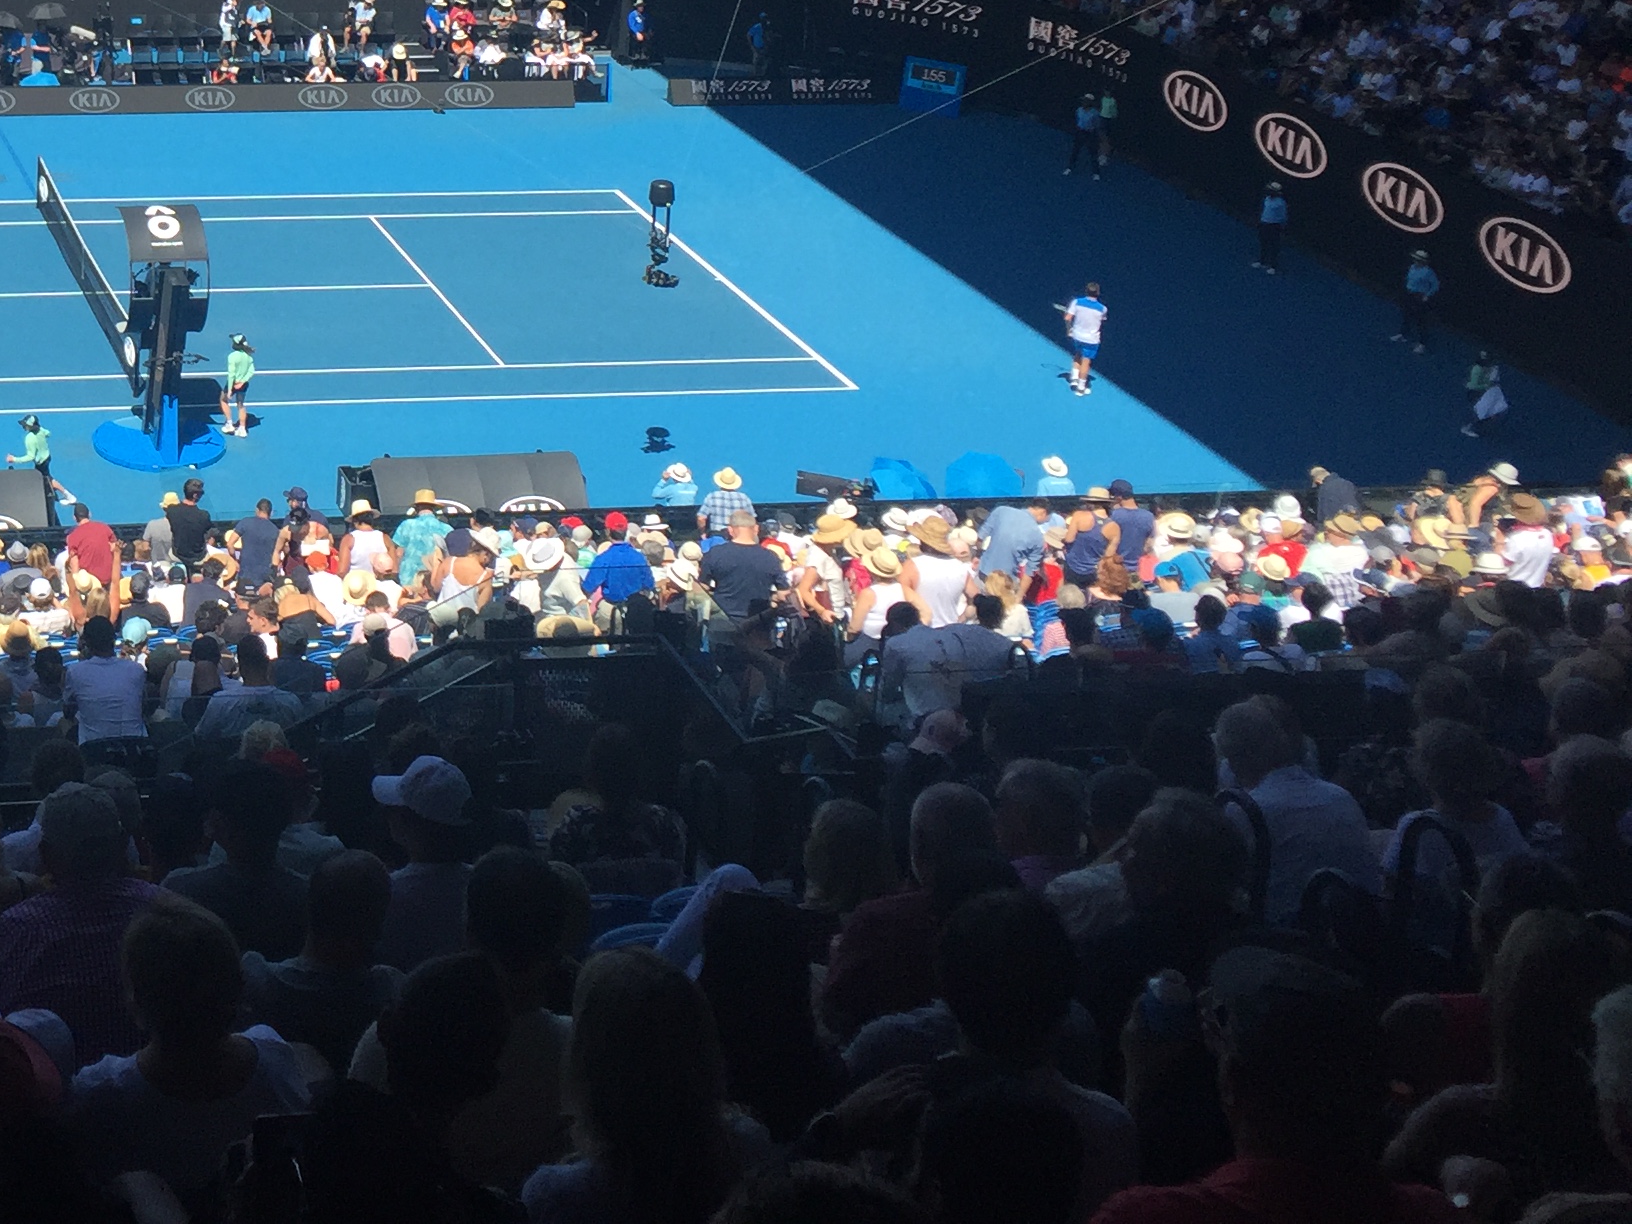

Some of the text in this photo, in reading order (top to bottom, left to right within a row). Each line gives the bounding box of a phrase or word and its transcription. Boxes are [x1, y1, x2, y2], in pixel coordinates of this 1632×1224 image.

[922, 69, 947, 83] 155
[78, 93, 112, 107] KIA
[193, 91, 227, 105] KIA
[306, 91, 341, 104] KIA
[380, 89, 414, 103] KIA
[453, 88, 487, 102] KIA
[1174, 78, 1216, 124] KIA
[1268, 121, 1313, 170] KIA
[1376, 171, 1428, 224] KIA
[1493, 225, 1553, 285] KIA
